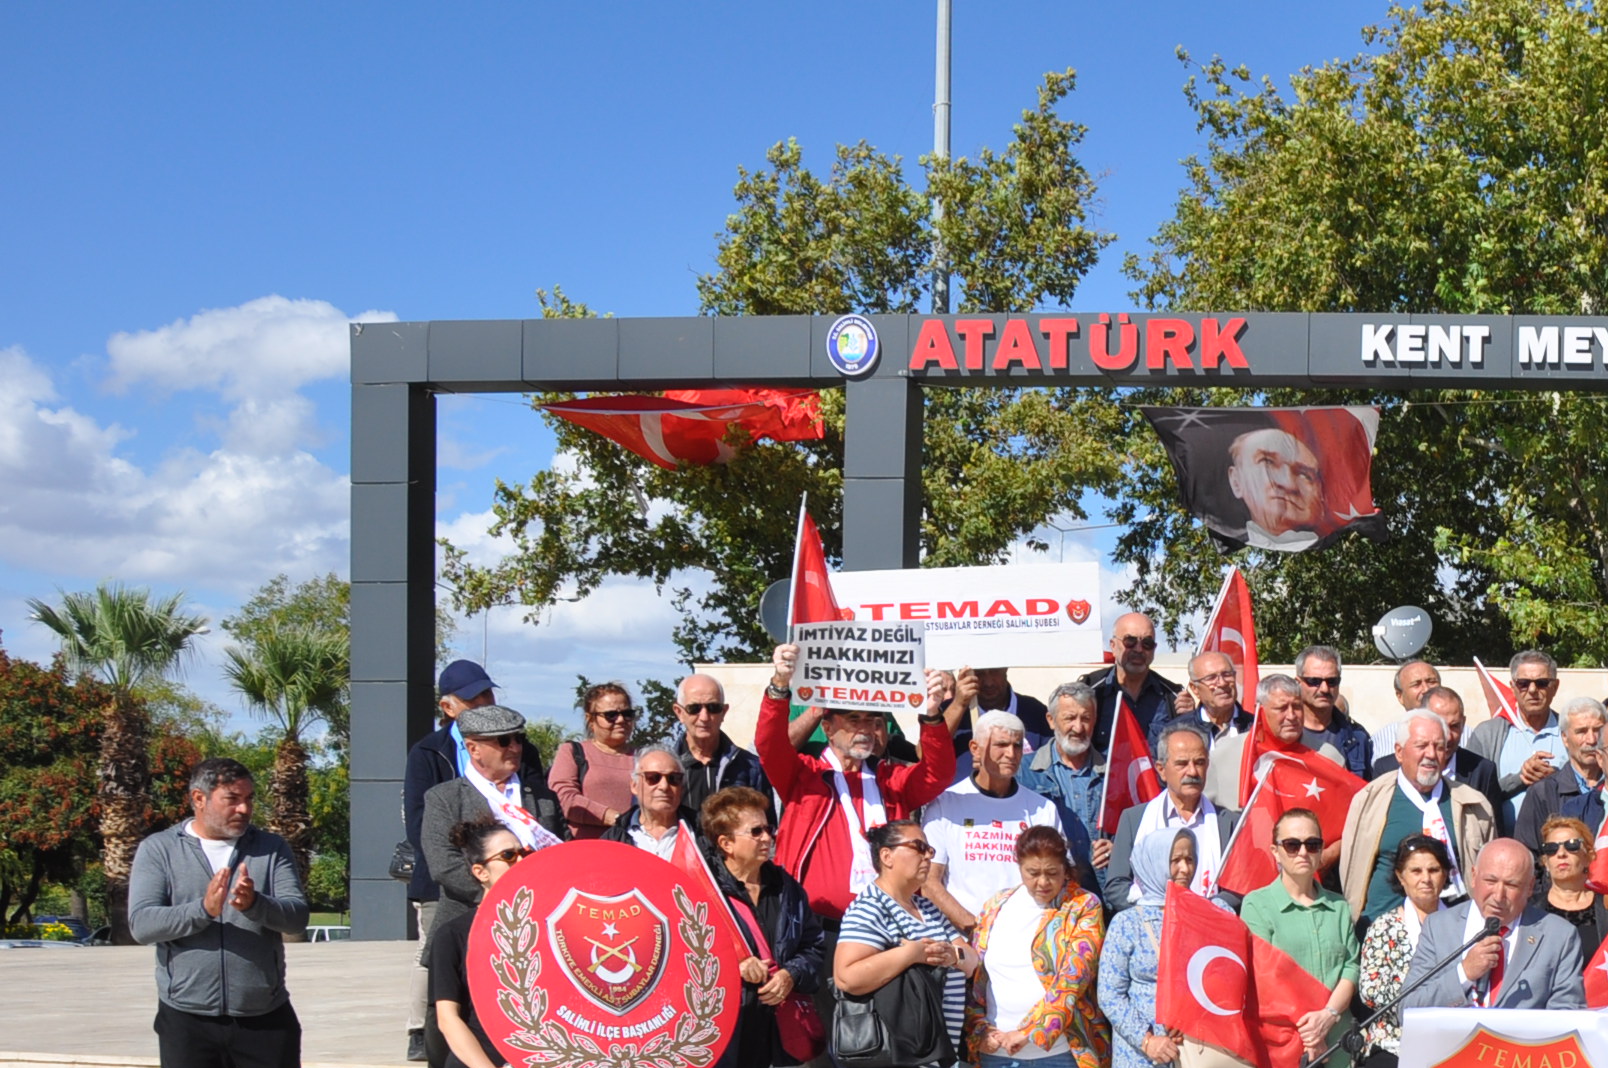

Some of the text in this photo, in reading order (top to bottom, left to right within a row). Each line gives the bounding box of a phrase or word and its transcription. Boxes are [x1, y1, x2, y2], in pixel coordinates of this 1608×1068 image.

[909, 313, 1249, 370] ATATÜRK
[1361, 323, 1490, 363] KENT
[860, 598, 1060, 621] TEMAD
[973, 617, 1004, 629] DERNEĞİ
[1006, 616, 1033, 628] SALİHLİ
[1034, 615, 1060, 628] ŞUBESİ
[799, 624, 922, 645] İMTİYAZ DEĞİL,
[807, 646, 914, 664] HAKKIMIZI
[804, 663, 917, 685] İSTİYORUZ.
[815, 686, 906, 703] TEMAD
[965, 831, 1020, 841] TAZMİNA
[576, 903, 641, 920] TEMAD
[556, 1004, 677, 1041] SALİHLİ İLÇE BAŞKANLIĞI
